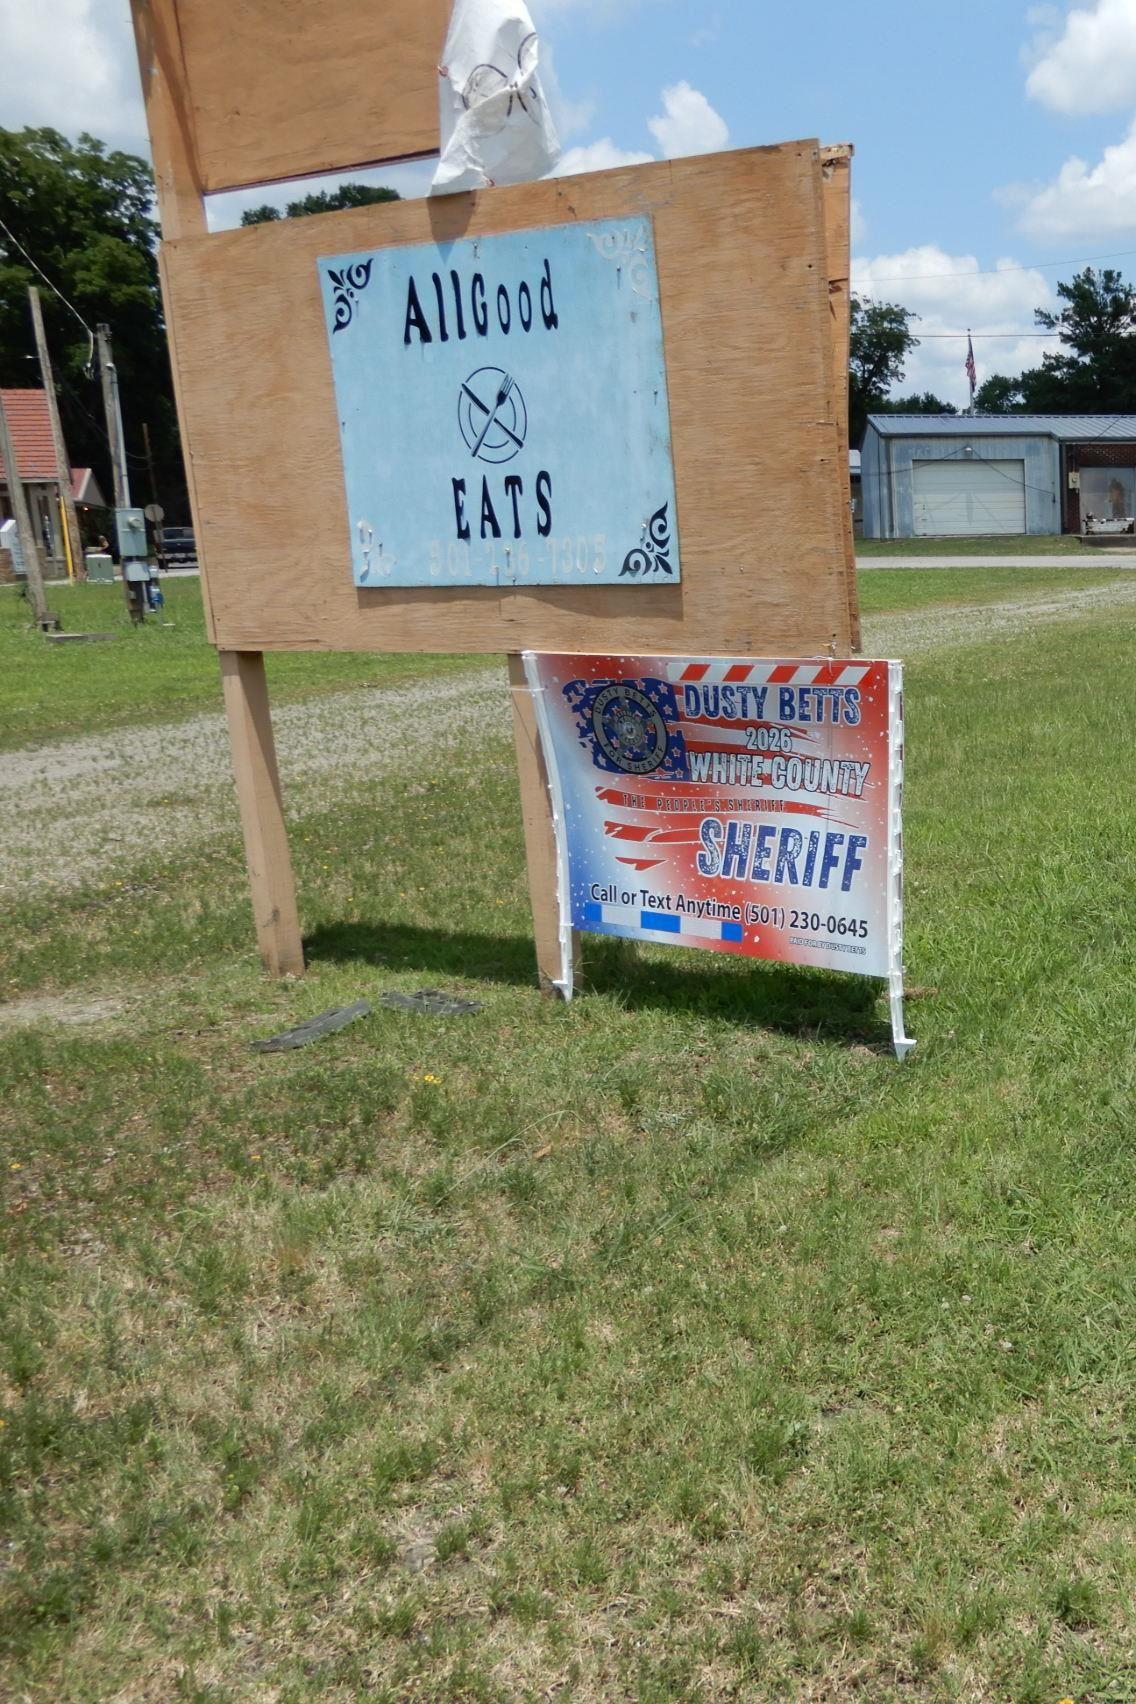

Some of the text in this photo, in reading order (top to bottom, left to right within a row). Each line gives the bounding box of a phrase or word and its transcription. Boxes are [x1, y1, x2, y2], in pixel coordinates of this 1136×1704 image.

[403, 258, 559, 345] AllGood
[452, 470, 552, 539] EATS
[595, 687, 619, 714] DUSTY
[683, 684, 860, 725] DUSTY BETTS
[745, 726, 792, 753] 2026
[689, 751, 871, 797] WHITE COUNTY
[623, 793, 785, 812] THE PEOPLE'S SHERIFF
[698, 818, 868, 892] SHERIFF
[591, 883, 869, 938] Call or Text Anytime (501) 230-0645
